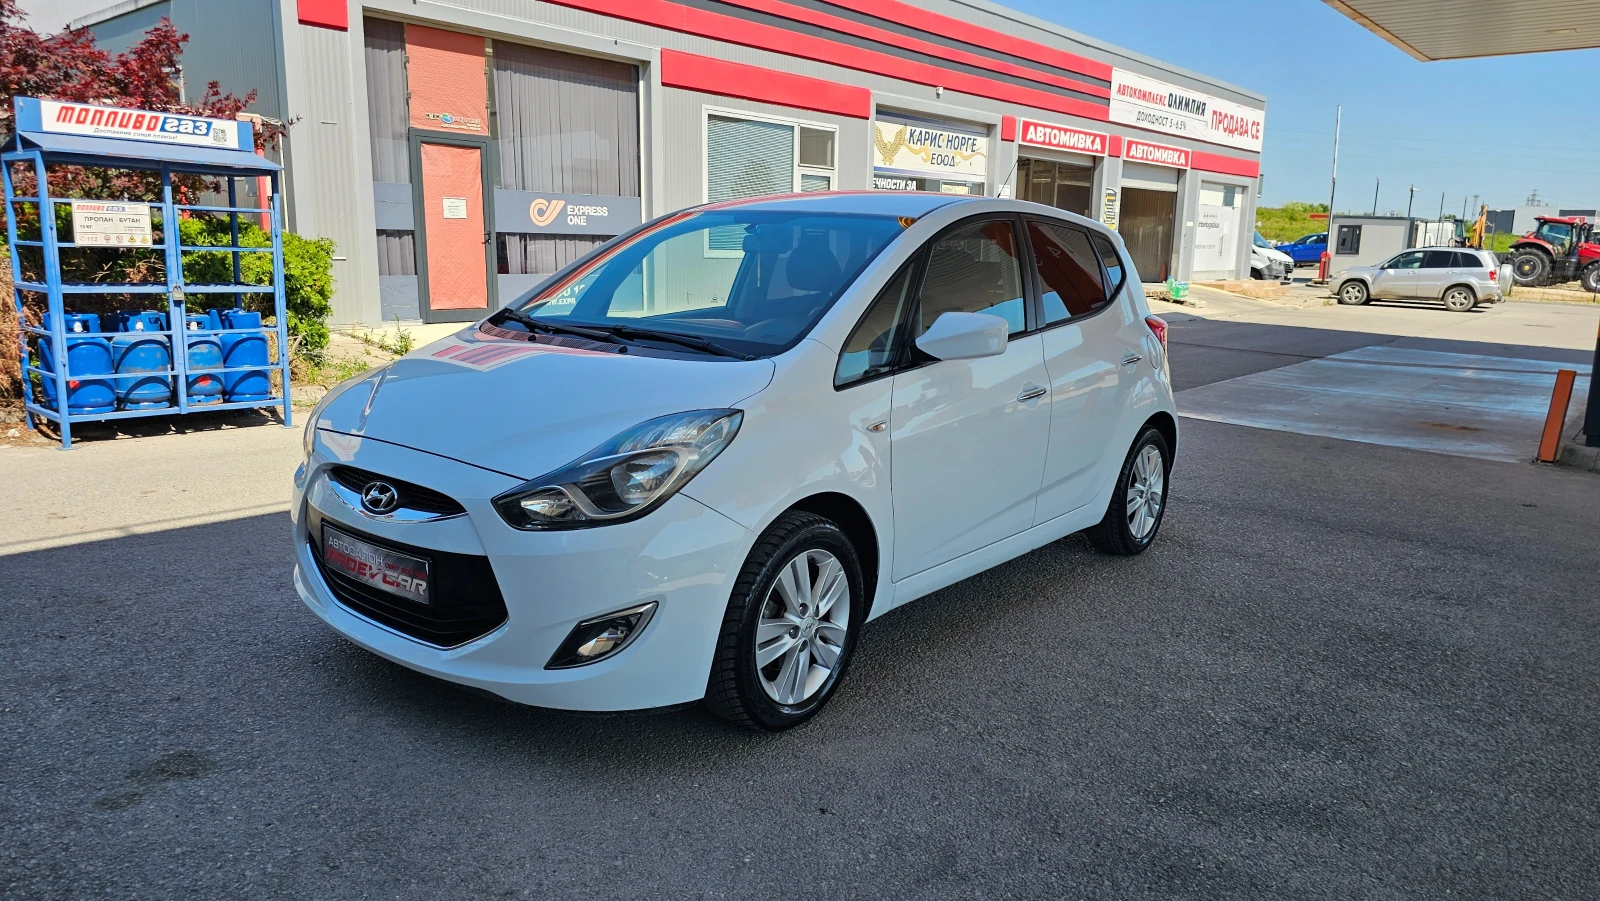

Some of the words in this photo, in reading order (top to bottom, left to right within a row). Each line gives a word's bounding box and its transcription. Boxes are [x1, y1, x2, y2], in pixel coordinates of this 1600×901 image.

[1116, 83, 1167, 107] АВТОКОМПЛЕКС
[1168, 92, 1207, 117] ОЛИМПИЯ
[1136, 110, 1169, 127] ДОХОДНОСТ
[1211, 109, 1249, 138] ПРОДАВА
[1250, 120, 1260, 140] СЕ
[908, 128, 944, 149] КАРИС
[946, 134, 978, 153] НОРГЕ
[1026, 125, 1101, 151] АВТОМИВКА
[930, 152, 955, 167] ЕООД
[1129, 143, 1186, 165] АВТОМИВКА
[906, 180, 917, 191] ЗА
[567, 205, 608, 217] EXPRESS
[567, 216, 587, 226] ONE
[328, 536, 383, 566] АВТОСАЛОН
